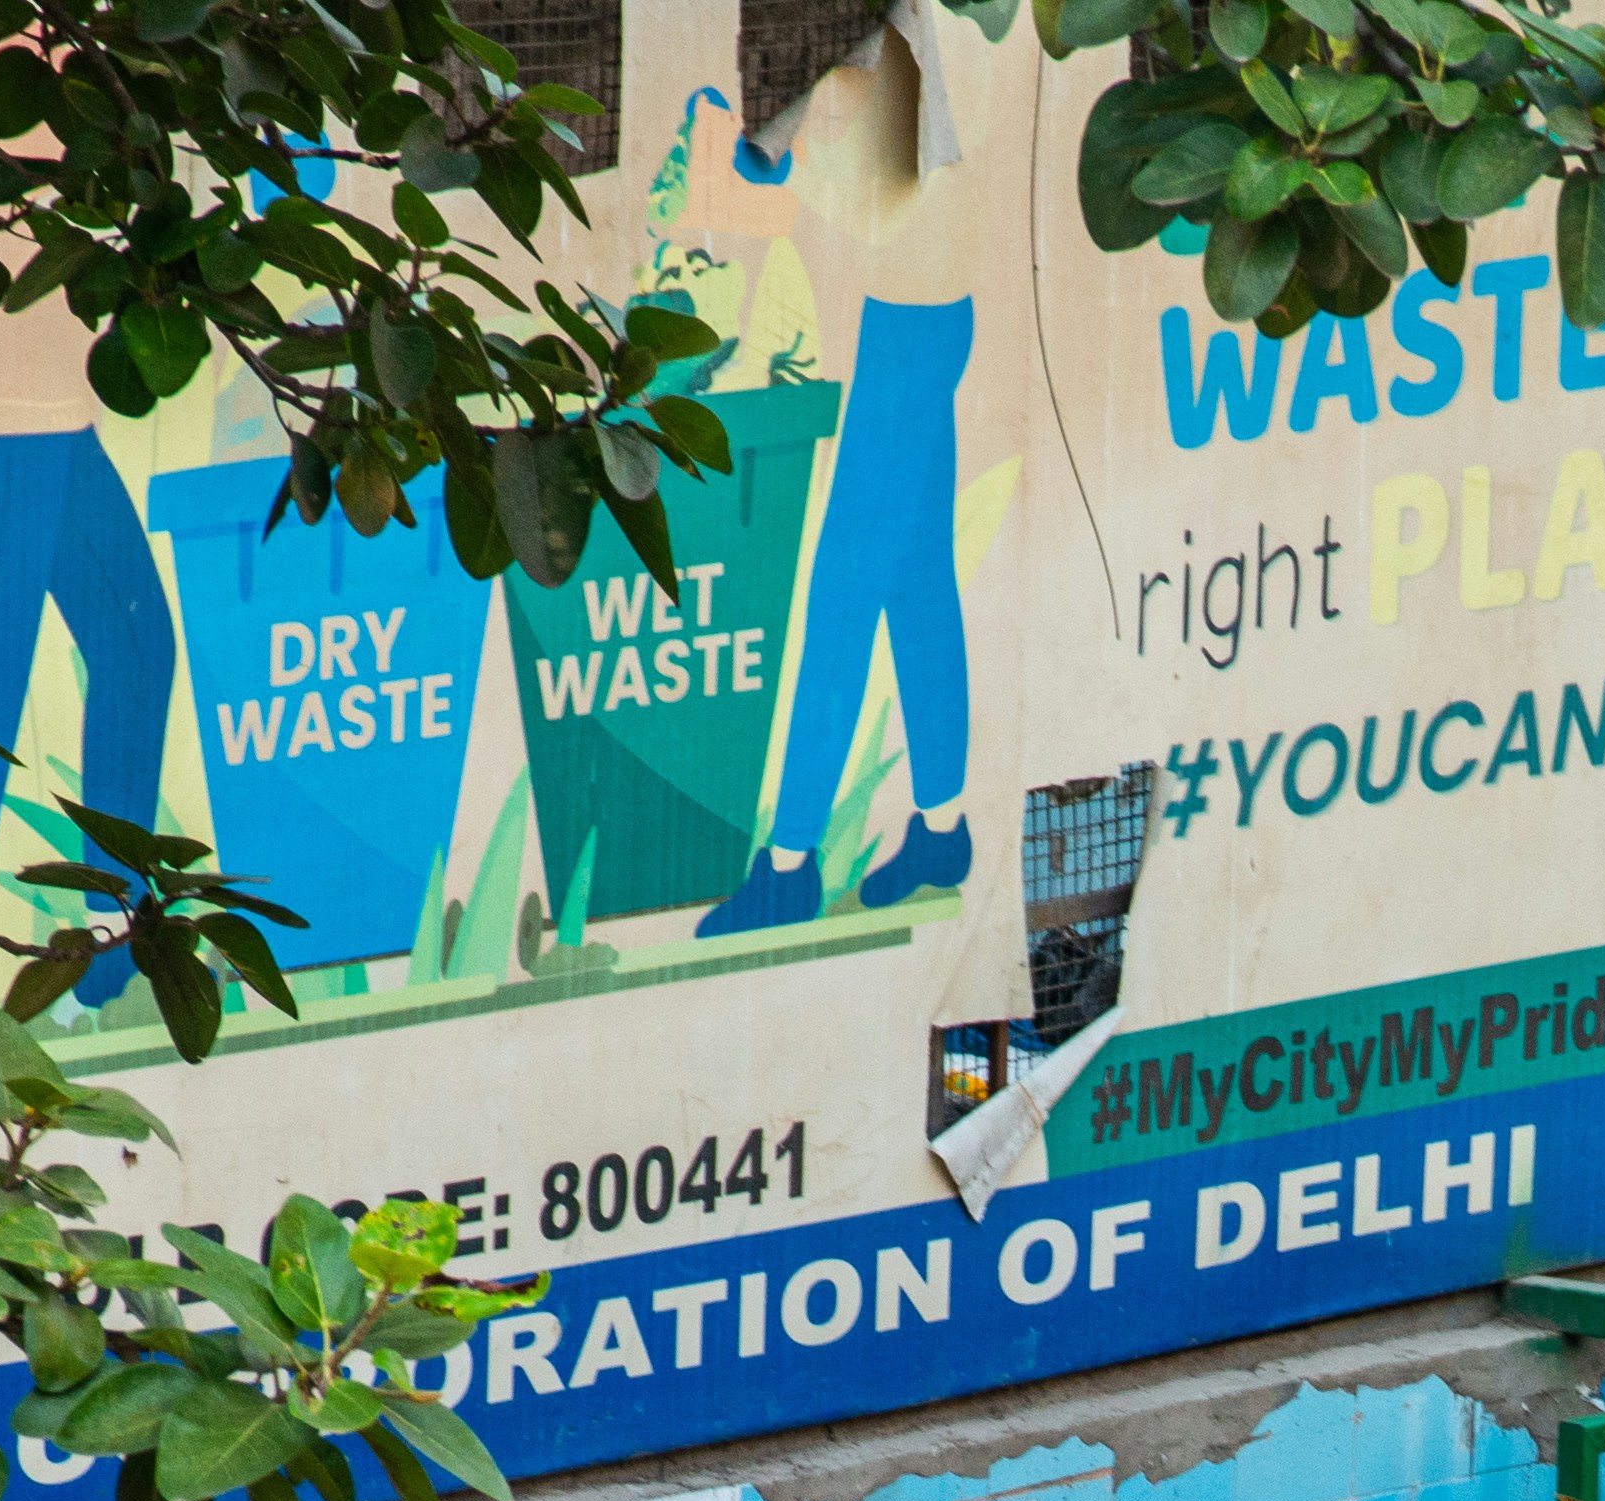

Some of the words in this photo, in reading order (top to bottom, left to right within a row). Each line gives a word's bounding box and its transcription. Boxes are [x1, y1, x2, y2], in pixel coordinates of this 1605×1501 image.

[582, 562, 725, 641] WET
[1135, 514, 1342, 669] right
[268, 606, 406, 687] DRY
[535, 627, 766, 720] WASTE
[215, 673, 454, 767] WASTE
[540, 1121, 806, 1242] 800441
[998, 1200, 1151, 1306] OF
[1194, 1122, 1537, 1270] DELHI
